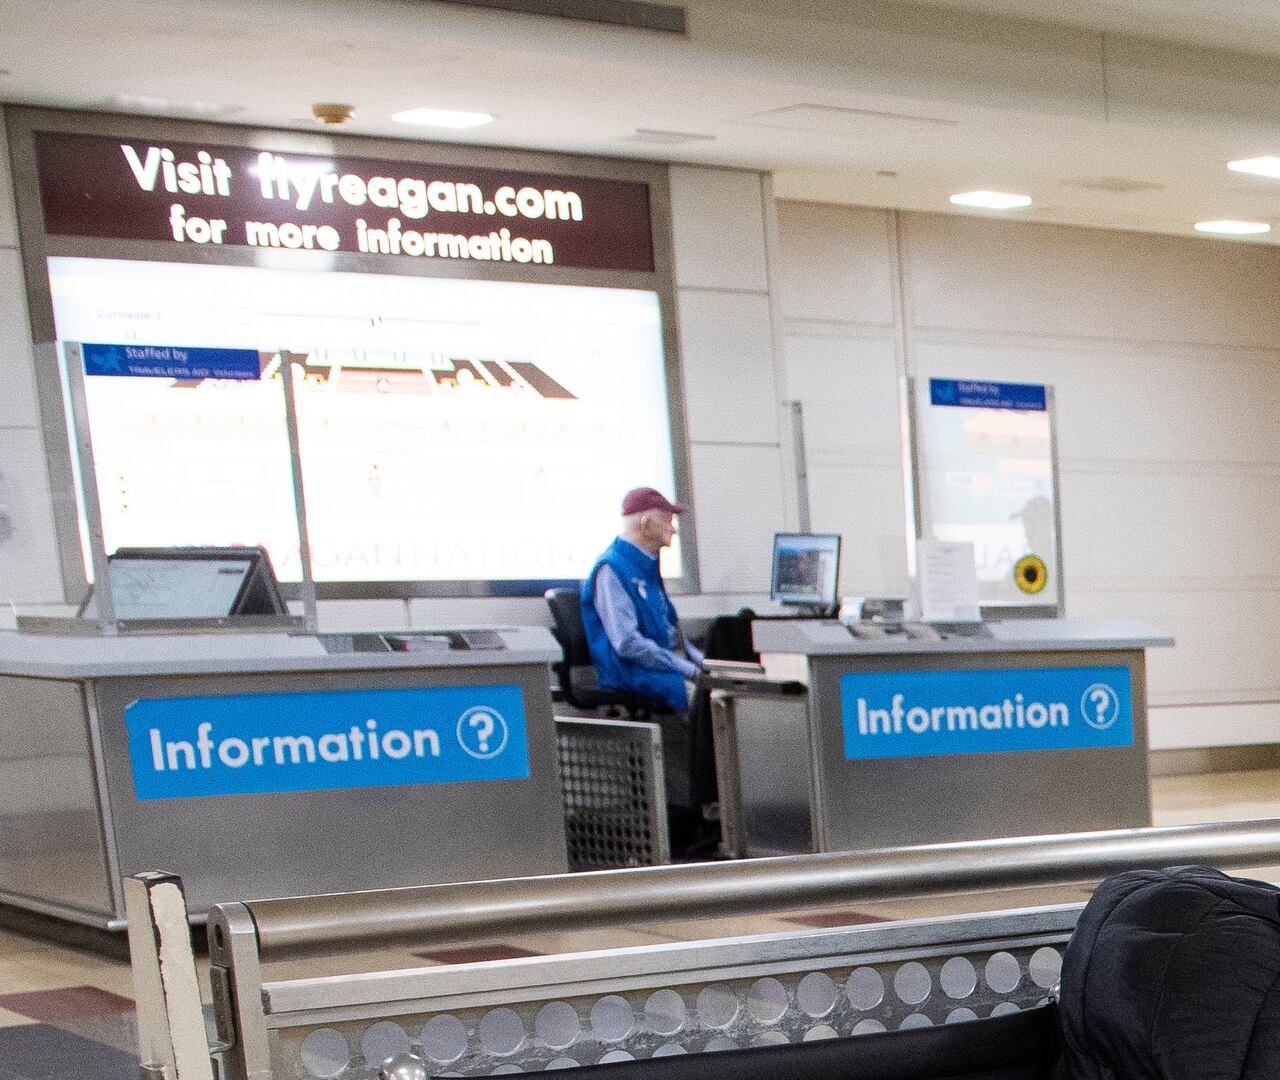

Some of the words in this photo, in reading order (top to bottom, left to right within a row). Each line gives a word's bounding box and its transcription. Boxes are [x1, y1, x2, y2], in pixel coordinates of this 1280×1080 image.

[120, 144, 232, 197] Visit
[257, 152, 584, 222] flyreagan.com
[169, 203, 228, 245] for
[245, 221, 341, 251] more
[356, 218, 554, 265] information
[856, 693, 1070, 736] Information
[149, 718, 440, 771] Information
